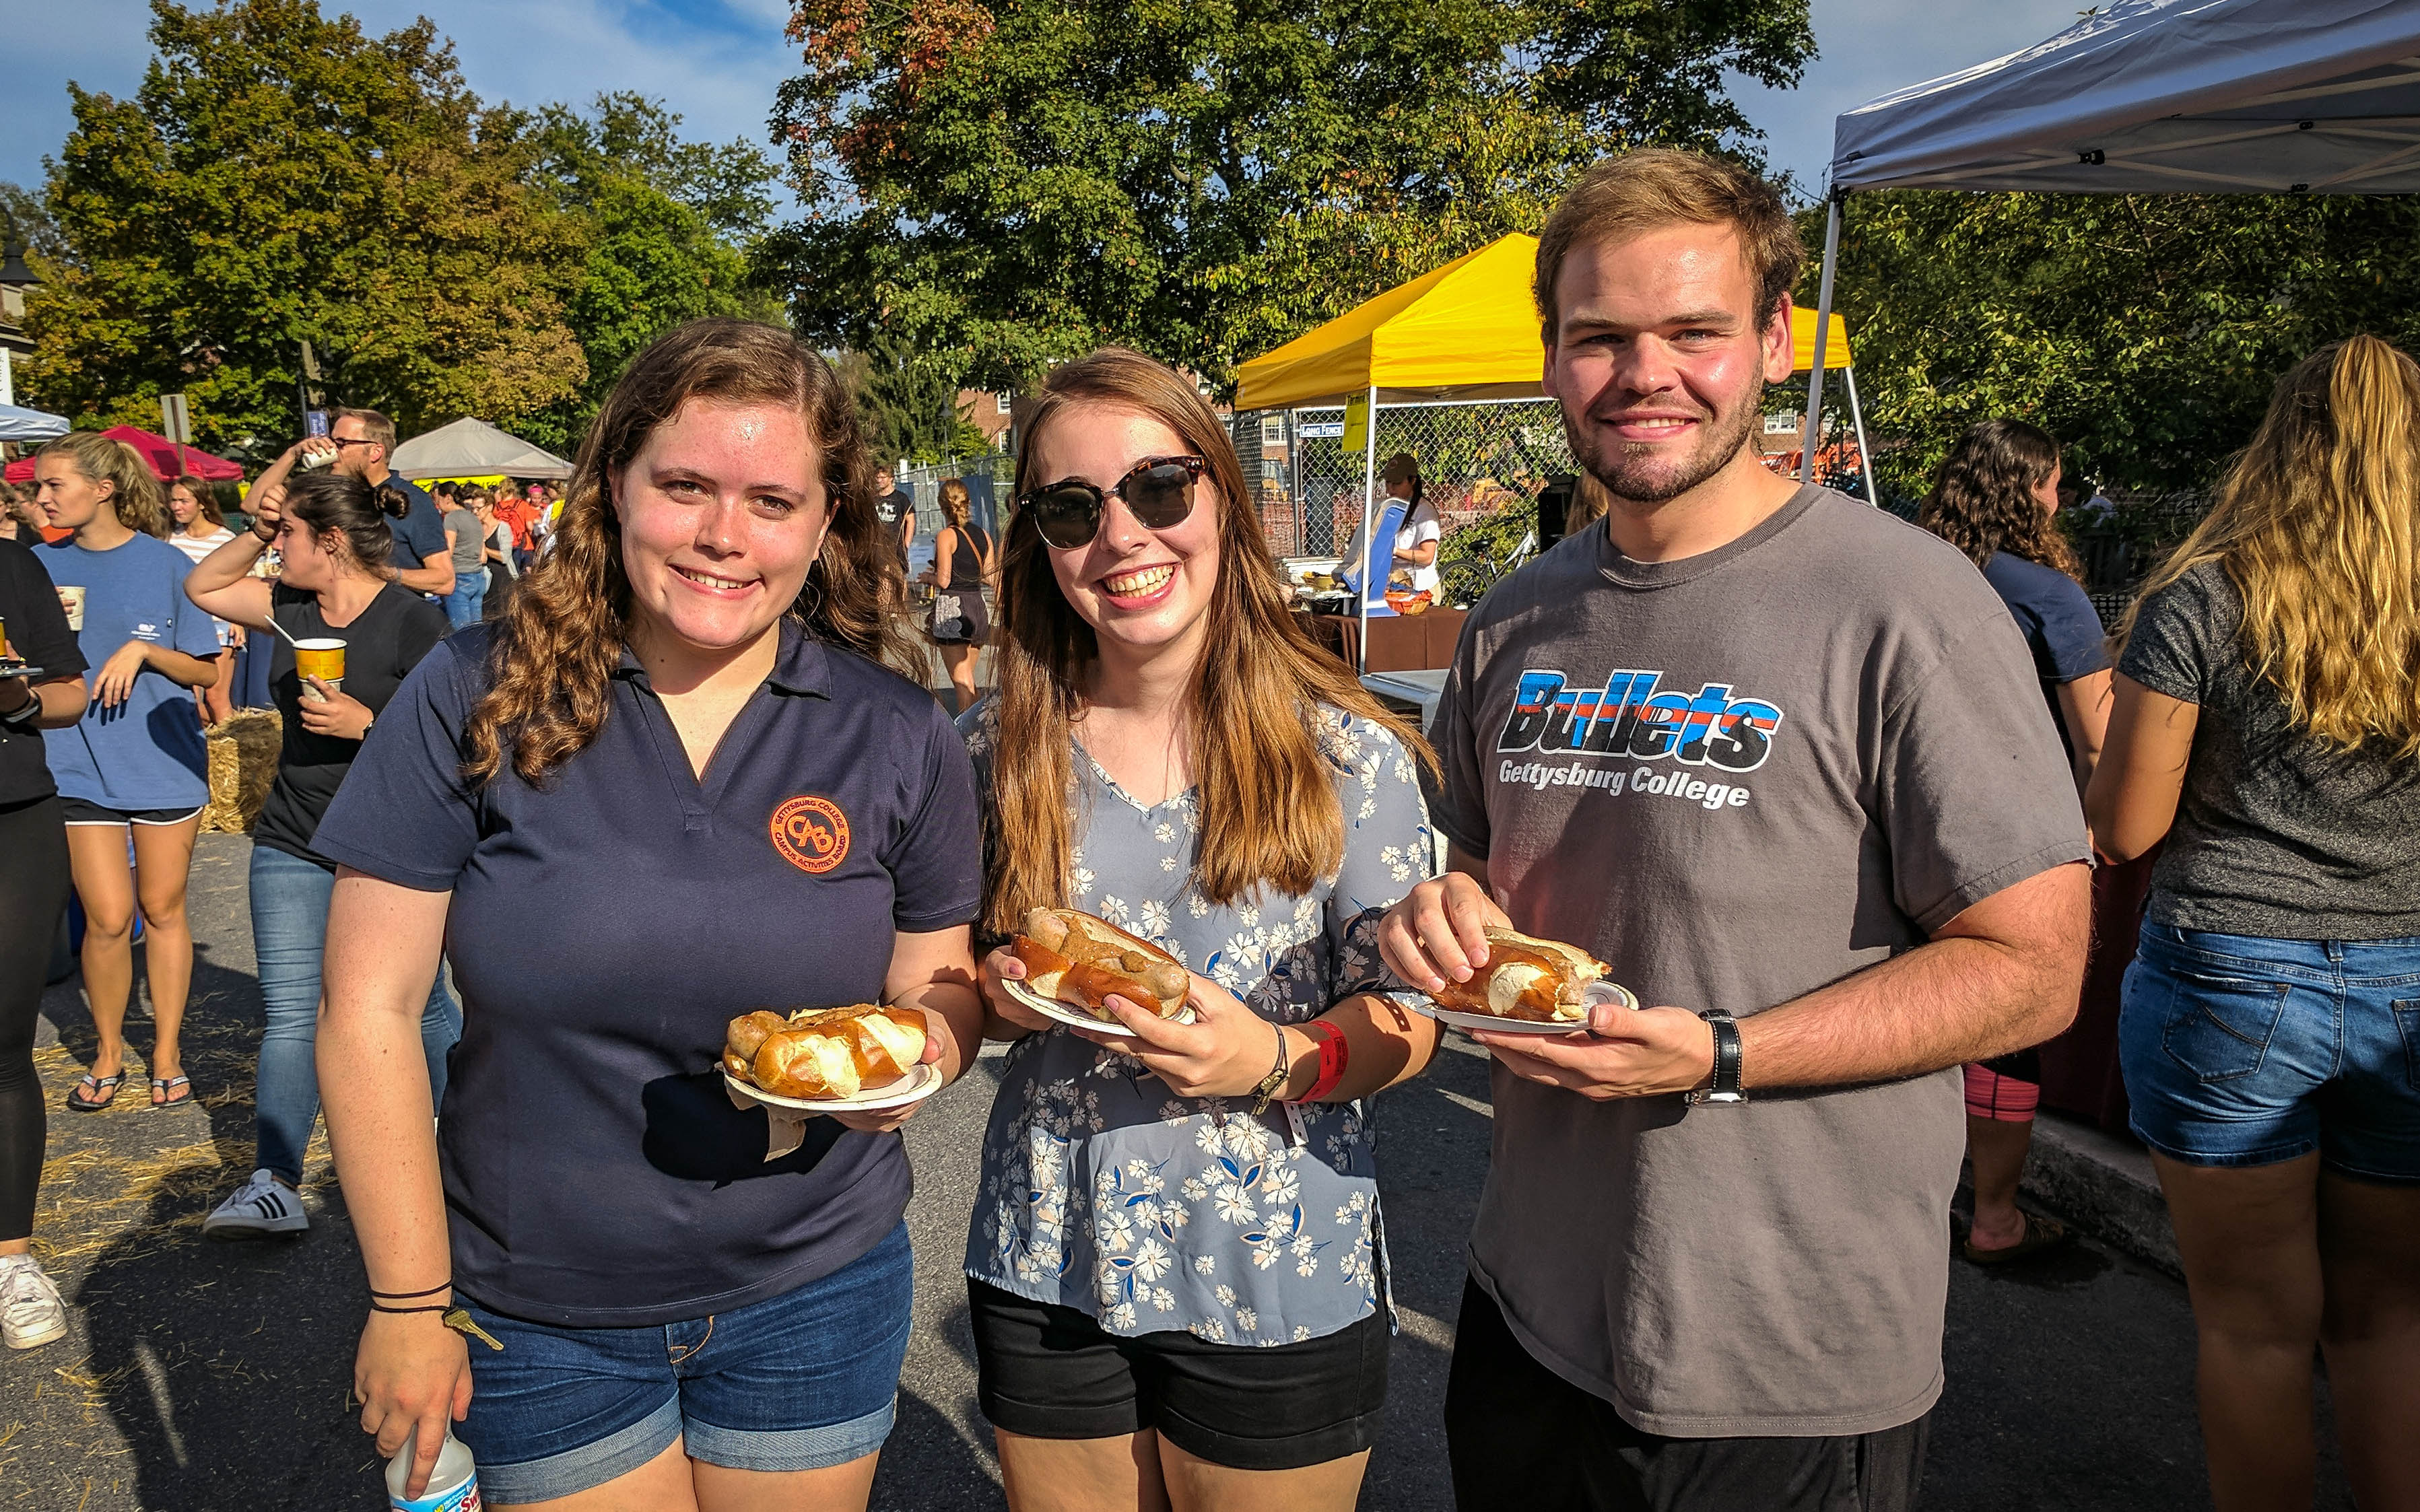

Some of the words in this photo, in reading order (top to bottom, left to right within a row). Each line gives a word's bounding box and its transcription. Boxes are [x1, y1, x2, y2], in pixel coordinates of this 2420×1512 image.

[1302, 425, 1320, 436] LONG
[1322, 425, 1342, 435] FENCE
[1497, 669, 1784, 773] Bullets
[1499, 759, 1627, 797] Gettysburg
[1630, 767, 1752, 810] College
[776, 800, 816, 824] GETTYSBURG
[818, 802, 844, 829] COLLEGE
[775, 832, 797, 860] CAMPUS
[798, 858, 834, 868] ACTIVITIES
[832, 835, 846, 860] BOARD
[787, 815, 834, 853] CAB
